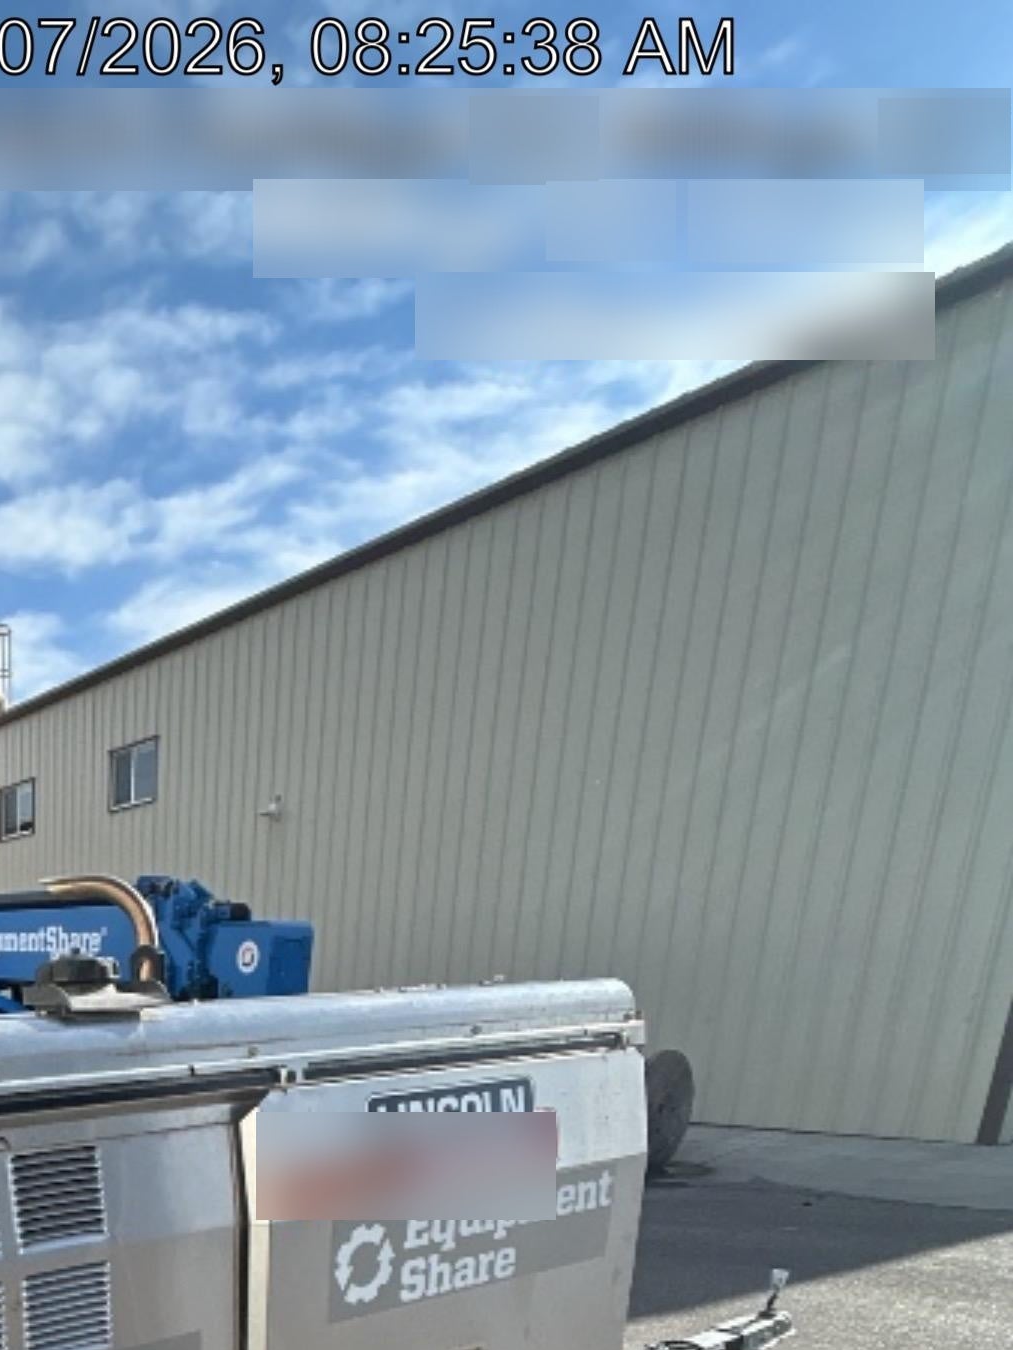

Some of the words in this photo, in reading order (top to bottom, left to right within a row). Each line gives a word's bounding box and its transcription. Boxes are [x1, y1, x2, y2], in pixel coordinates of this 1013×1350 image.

[376, 1085, 526, 1113] COLN
[403, 1169, 614, 1252] Equpent
[399, 1246, 517, 1303] Share
